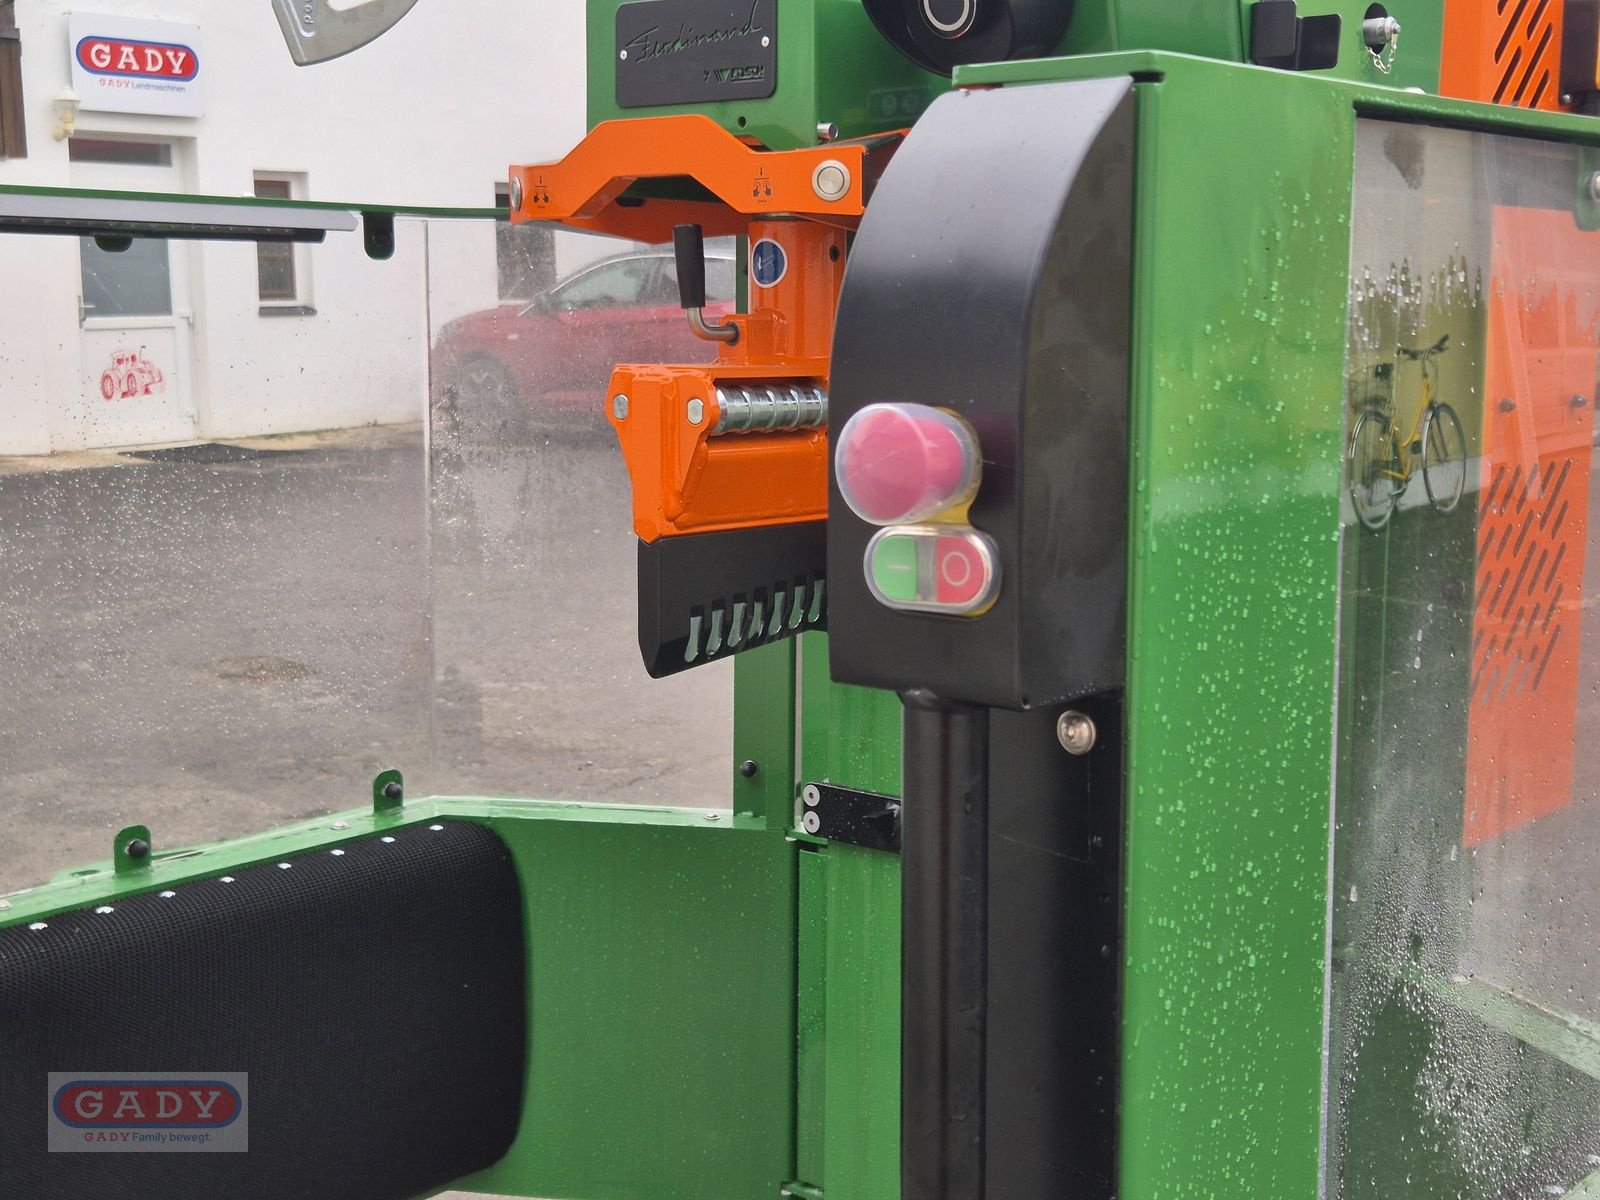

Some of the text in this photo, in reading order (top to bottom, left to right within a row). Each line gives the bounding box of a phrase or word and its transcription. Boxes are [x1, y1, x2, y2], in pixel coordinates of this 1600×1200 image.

[90, 42, 187, 74] GADY
[99, 78, 186, 93] GADY Landmaschinen
